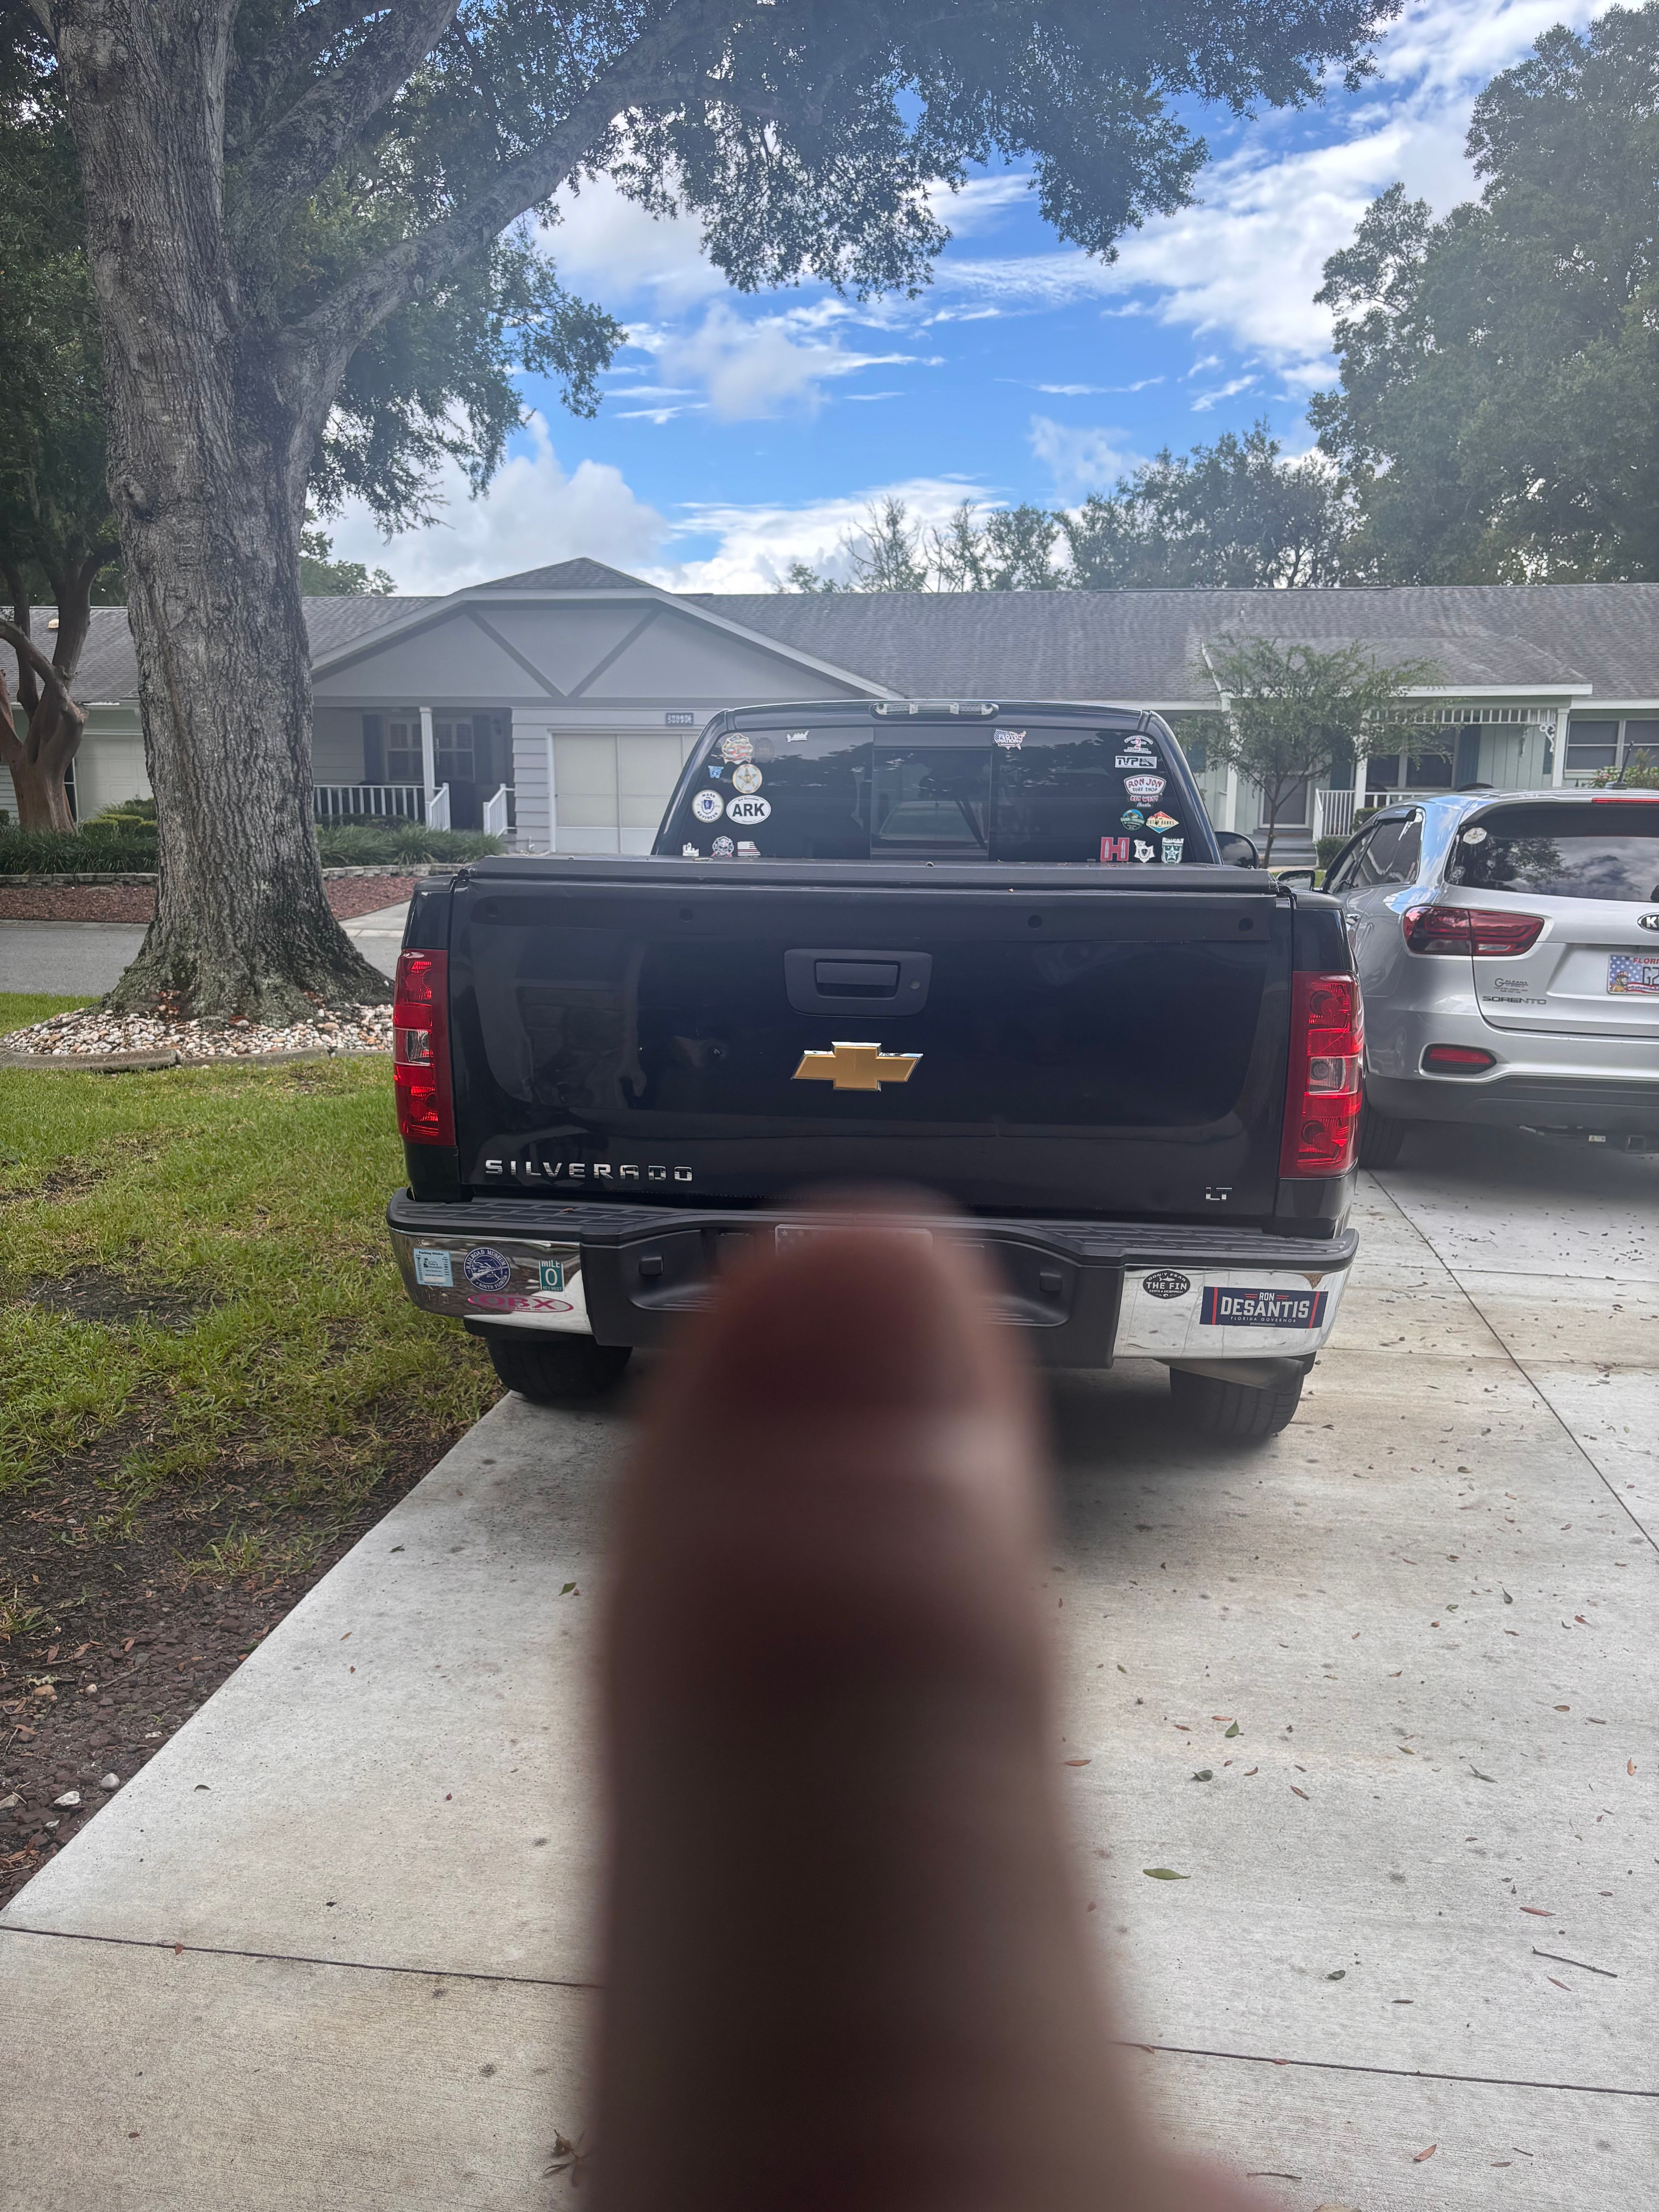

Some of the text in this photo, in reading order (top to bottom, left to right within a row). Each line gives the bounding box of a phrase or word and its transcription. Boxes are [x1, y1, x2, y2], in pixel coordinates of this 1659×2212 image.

[1128, 778, 1162, 788] RON JON
[732, 803, 765, 817] ARK
[1482, 996, 1547, 1005] SORENTO
[485, 1159, 692, 1181] SILVERADO
[1206, 1187, 1232, 1200] LT
[466, 1249, 485, 1269] RAILROAD
[487, 1250, 507, 1266] MUSEUM
[541, 1259, 561, 1268] MILE
[494, 1275, 508, 1288] FLORIDA
[1170, 1273, 1186, 1282] FEAR
[1259, 1292, 1274, 1301] RON
[479, 1297, 557, 1310] OBX
[1220, 1296, 1310, 1319] DESANTIS
